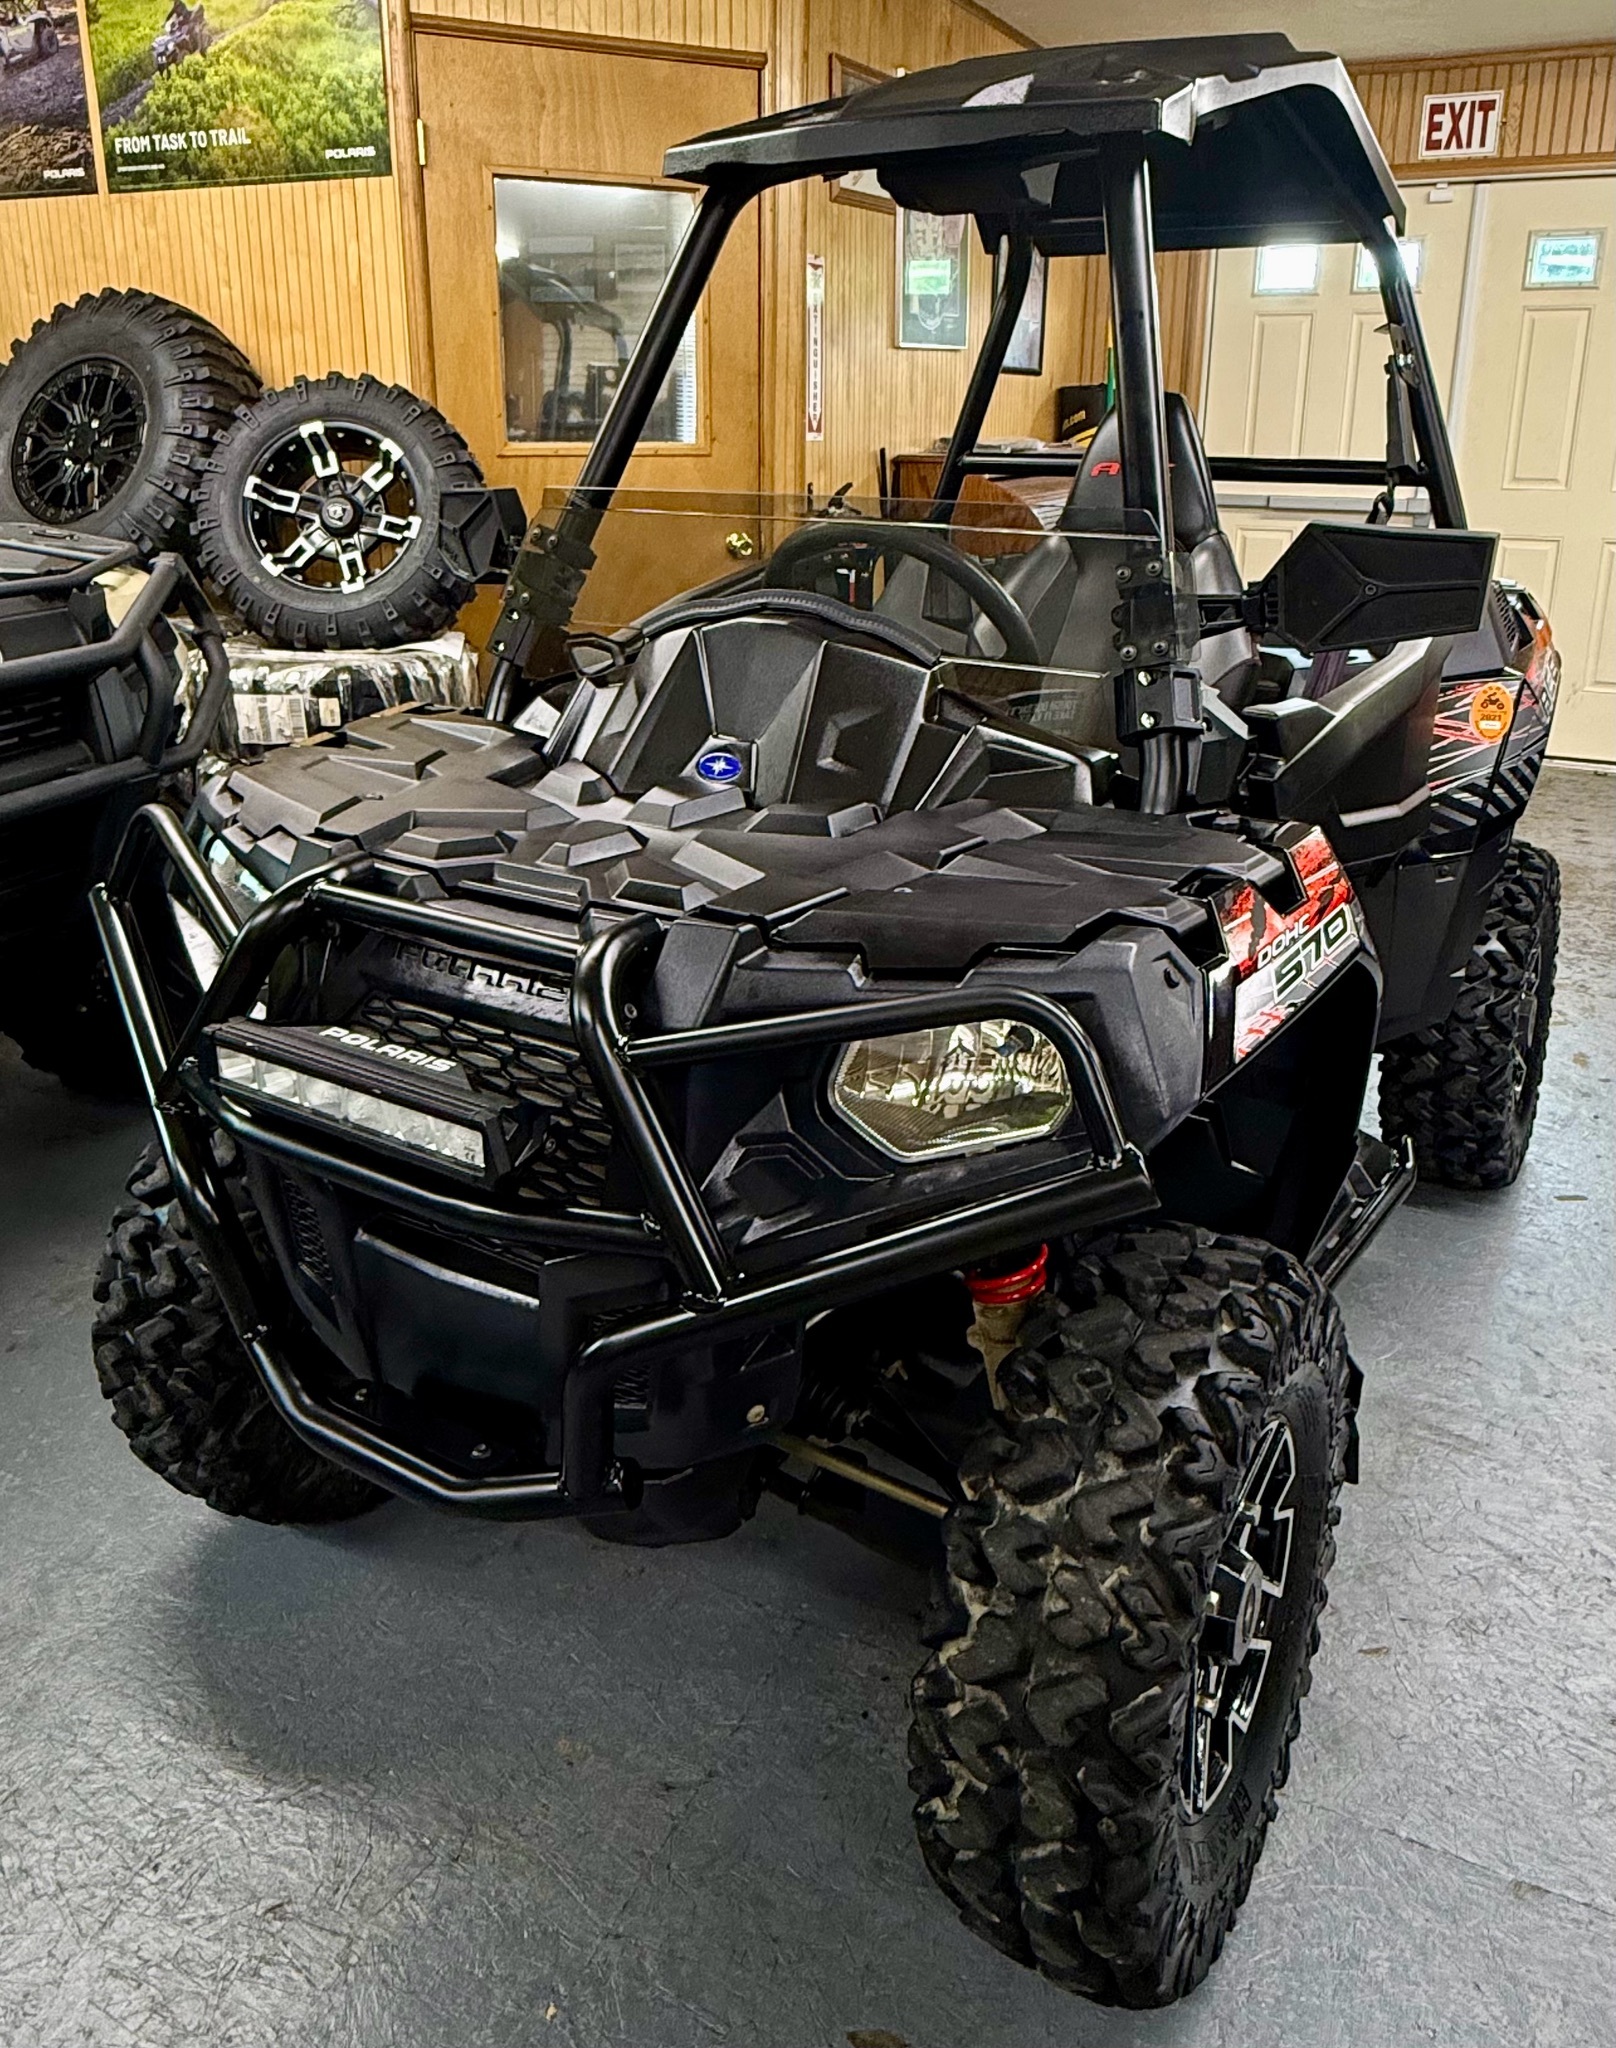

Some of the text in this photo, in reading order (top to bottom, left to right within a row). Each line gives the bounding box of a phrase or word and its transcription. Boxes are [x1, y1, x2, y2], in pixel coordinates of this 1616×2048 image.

[114, 127, 251, 154] FROM TASK TO TRAIL
[1425, 99, 1497, 151] EXIT
[43, 167, 85, 179] POLARIS
[325, 145, 376, 159] POLARIS
[1257, 913, 1311, 970] DOHC
[1271, 902, 1351, 1005] 570
[318, 1026, 457, 1072] POLARIS
